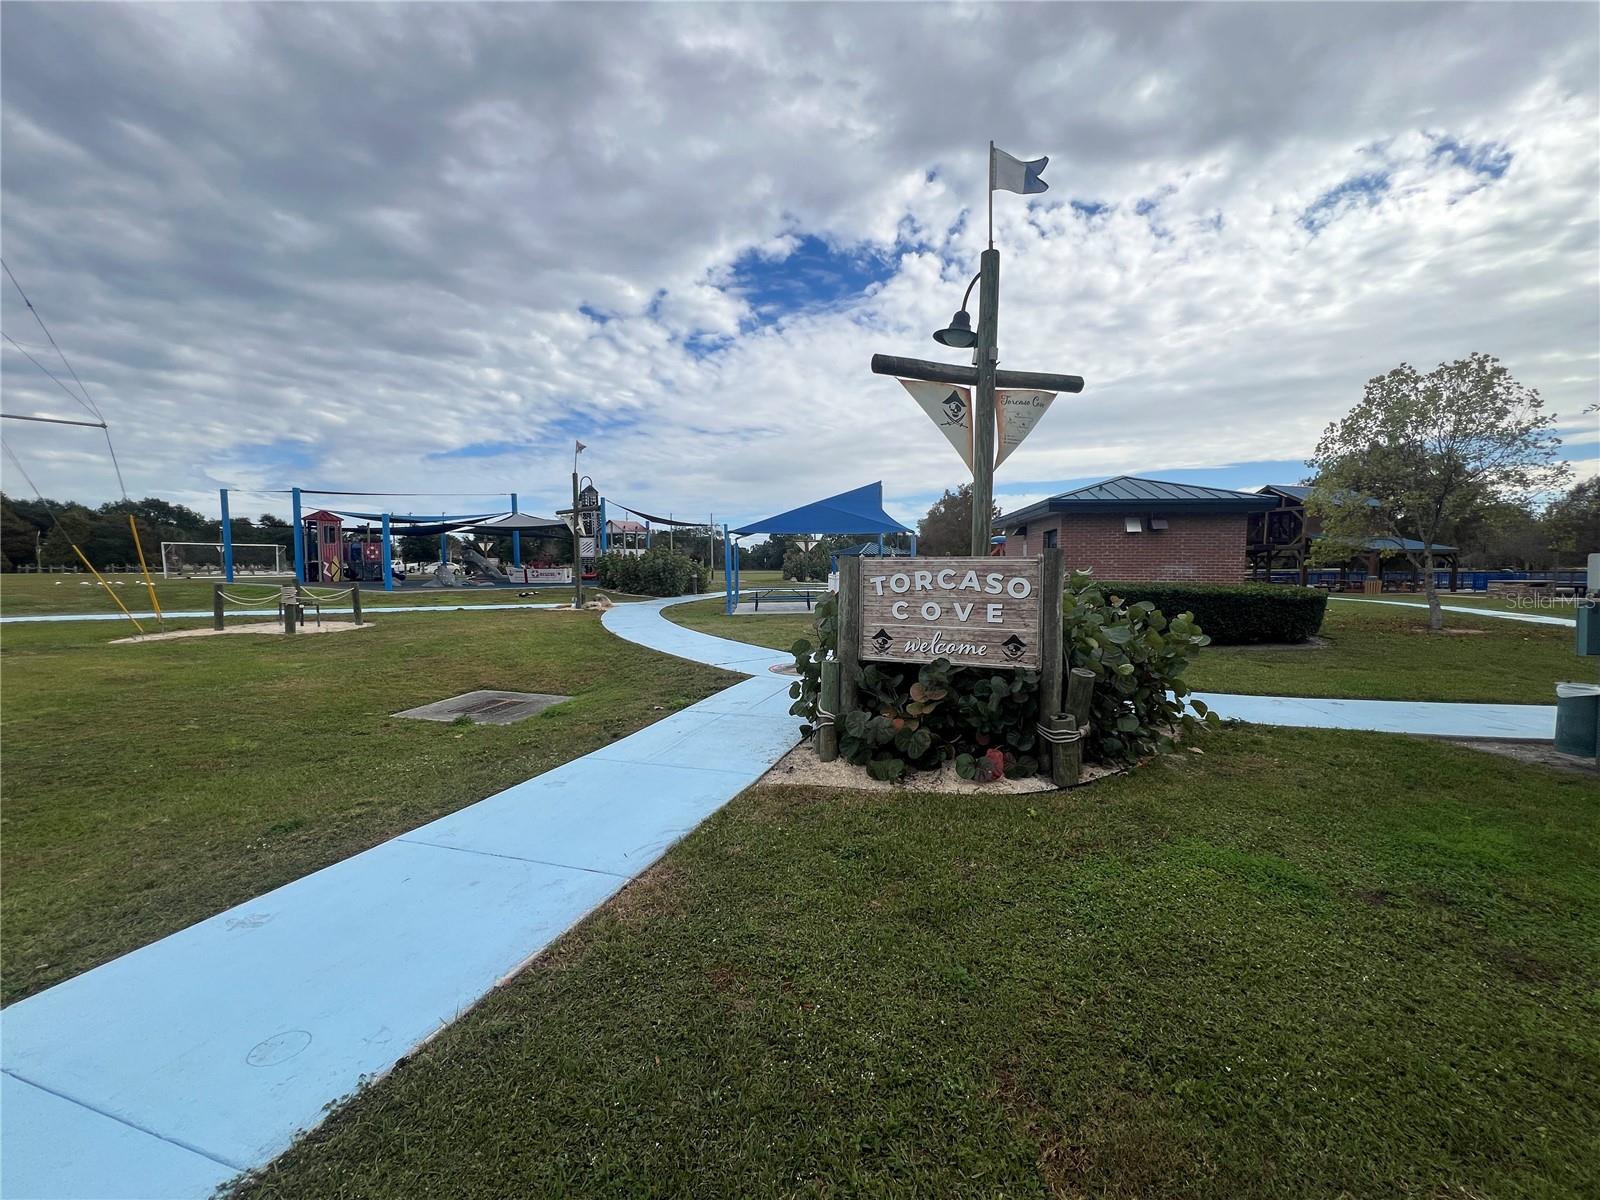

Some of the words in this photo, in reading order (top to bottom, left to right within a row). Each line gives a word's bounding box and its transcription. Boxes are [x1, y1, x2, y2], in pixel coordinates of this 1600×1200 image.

[870, 569, 1032, 599] TORCASO
[891, 601, 1004, 623] COVE
[903, 631, 988, 656] welcome
